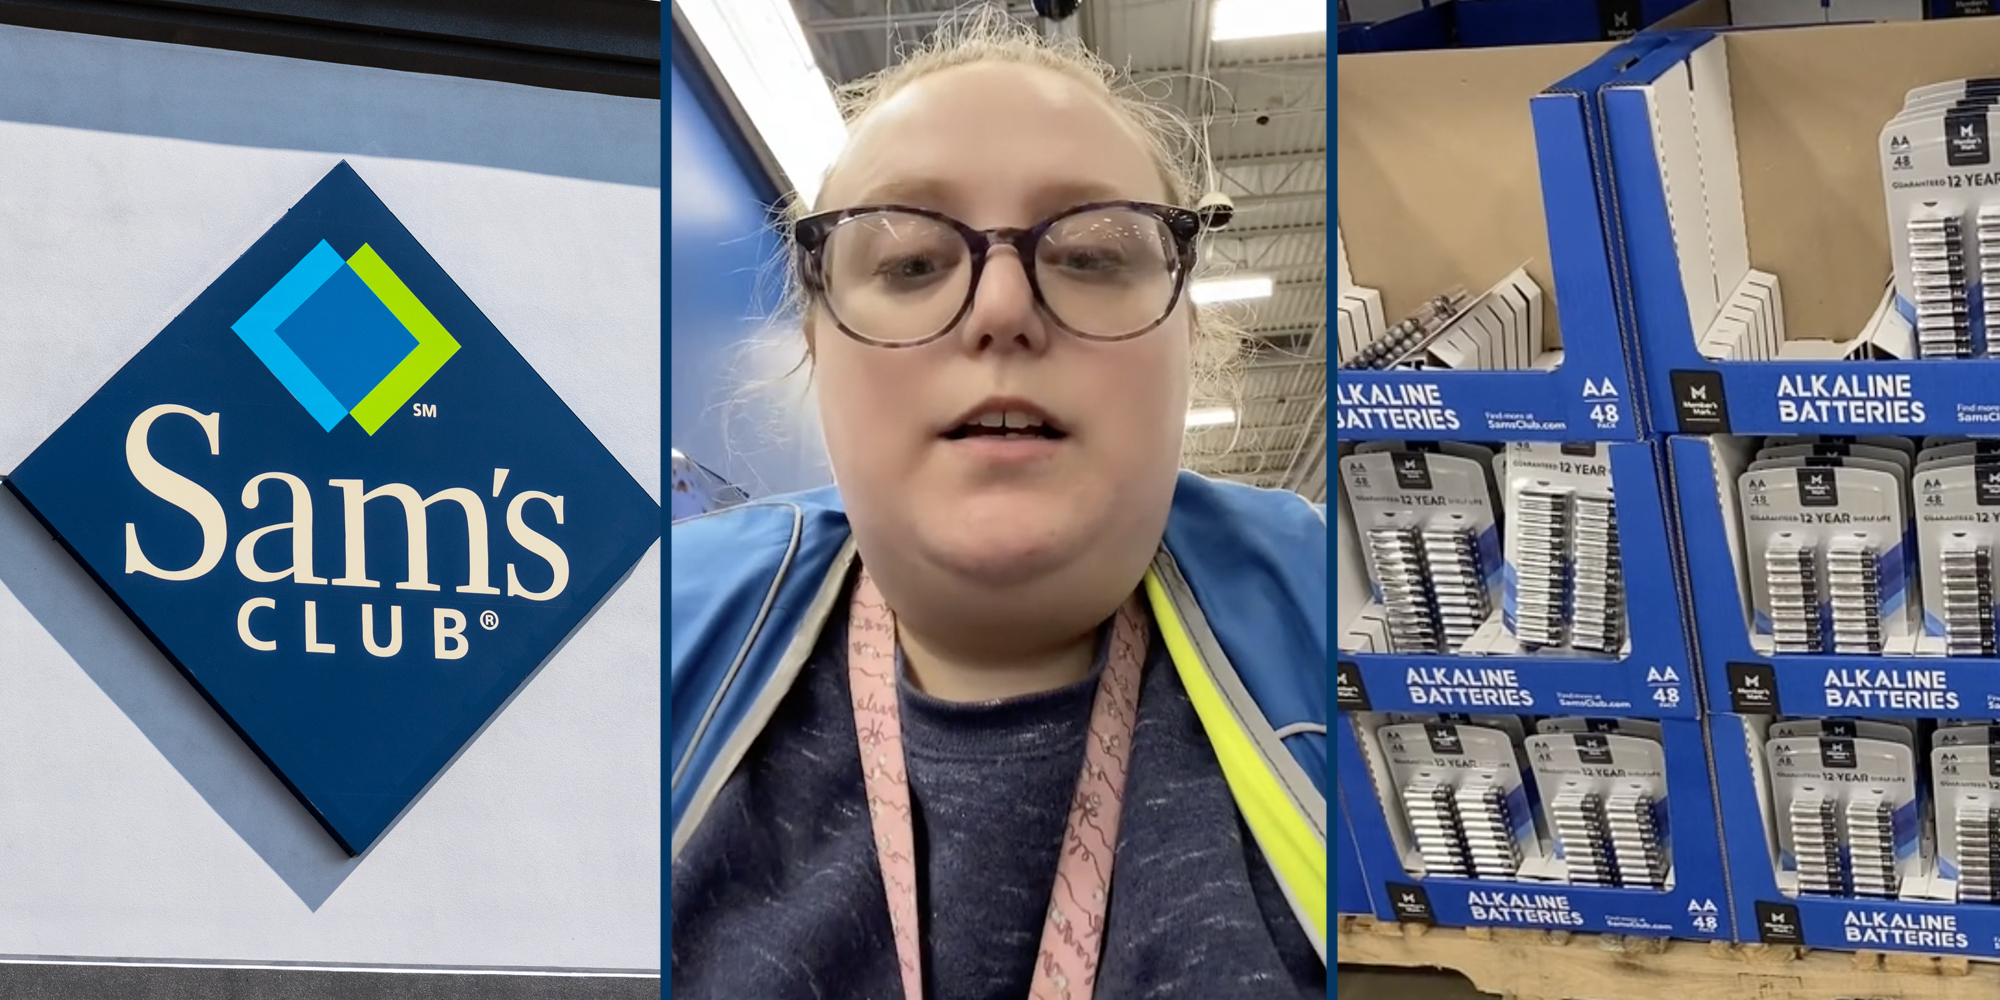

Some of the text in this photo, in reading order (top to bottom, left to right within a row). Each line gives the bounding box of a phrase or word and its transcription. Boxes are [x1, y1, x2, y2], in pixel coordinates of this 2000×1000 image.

[1890, 135, 1910, 149] AA
[1894, 155, 1911, 167] 48
[1948, 175, 1962, 188] 12
[1337, 383, 1443, 405] LKALINE
[1582, 377, 1618, 397] AA
[1777, 374, 1911, 398] ALKALINE
[413, 402, 437, 418] SM
[1590, 404, 1619, 422] 48
[1682, 401, 1718, 409] Member's
[1778, 400, 1926, 424] BATTERIES
[1957, 403, 1975, 411] Find
[1488, 420, 1566, 430] SamsClub.com
[1560, 461, 1571, 473] 12
[1574, 462, 1606, 476] YEAR
[125, 403, 570, 601] Sam's
[1400, 495, 1413, 505] 12
[1415, 496, 1446, 506] YEAR
[1800, 513, 1812, 523] 12
[1816, 513, 1850, 524] YEAR
[1976, 512, 1989, 523] 12
[1406, 667, 1519, 687] ALKALINE
[1646, 665, 1680, 682] AA
[1824, 669, 1946, 689] ALKALINE
[1409, 687, 1534, 707] BATTERIES
[1653, 687, 1680, 703] 48
[1825, 690, 1959, 710] BATTERIES
[1559, 699, 1631, 708] SamsClub.com
[1596, 768, 1626, 778] YEAR
[1823, 772, 1835, 781] 12
[1838, 772, 1868, 783] YEAR
[1468, 891, 1570, 911] ALKALINE
[1687, 899, 1718, 912] AA
[1471, 906, 1584, 926] BATTERIES
[1693, 916, 1718, 930] 48
[1844, 911, 1956, 931] ALKALINE
[1845, 927, 1968, 948] BATTERIES
